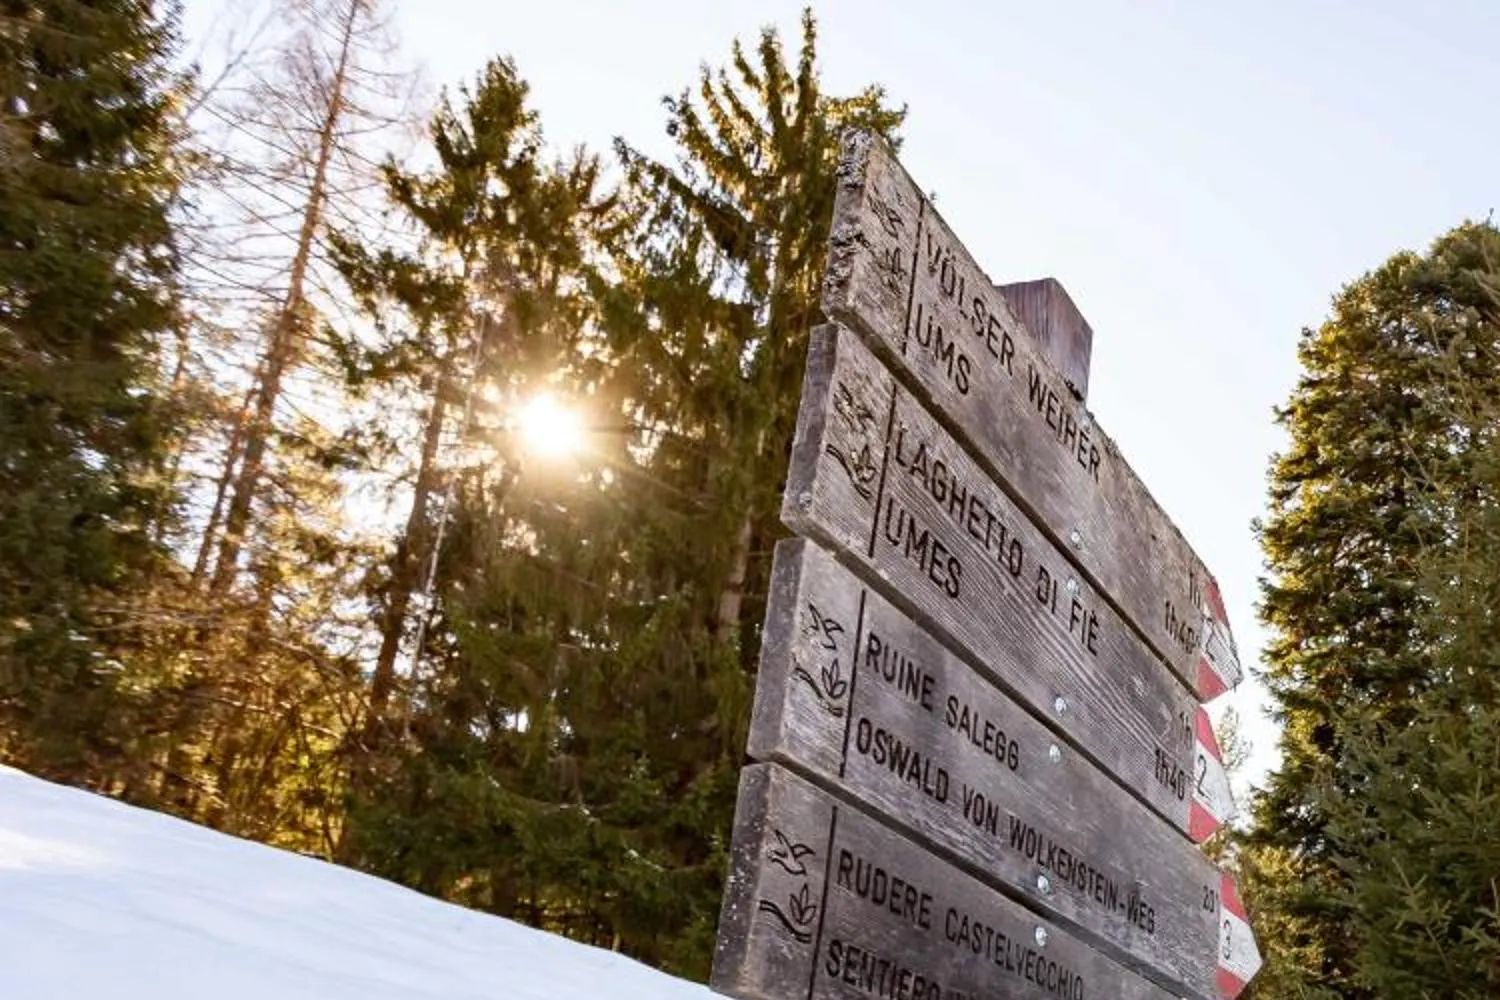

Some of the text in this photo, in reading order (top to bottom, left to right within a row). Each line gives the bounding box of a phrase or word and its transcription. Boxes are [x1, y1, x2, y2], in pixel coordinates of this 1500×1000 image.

[915, 303, 971, 395] UMS
[927, 233, 1101, 483] VÖLSER WEIHER
[885, 497, 962, 599] UMES
[895, 422, 1023, 578] LAGHETTO
[1036, 564, 1058, 614] DI
[865, 631, 1020, 773] RUINE SALEGG
[856, 717, 1156, 935] OSWALD VON WOLKENSTEIN-WEG
[1197, 754, 1212, 800] 2
[837, 849, 933, 931] RUDERE
[1222, 919, 1232, 960] 3
